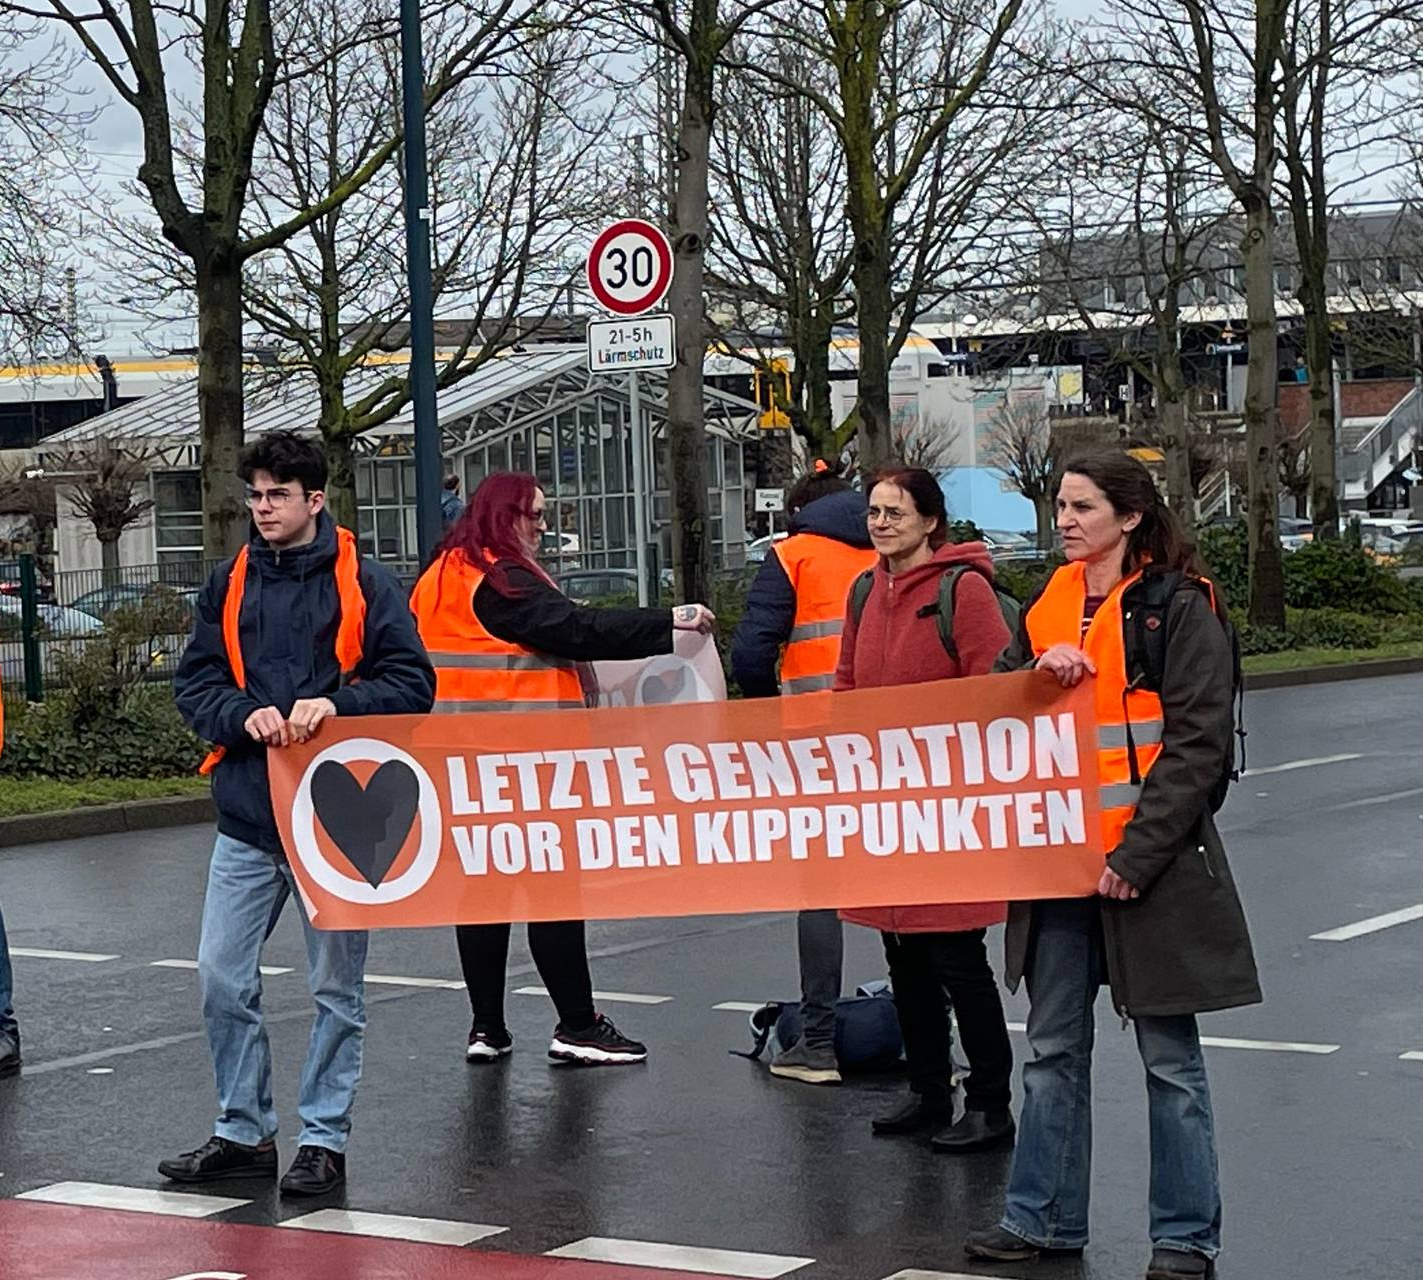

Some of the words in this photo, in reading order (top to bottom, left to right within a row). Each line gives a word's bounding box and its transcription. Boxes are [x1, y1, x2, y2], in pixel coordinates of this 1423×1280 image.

[606, 246, 653, 289] 30
[598, 345, 664, 364] Lärmschutz
[446, 745, 656, 815] LETZTE
[663, 712, 1080, 803] GENERATION
[450, 822, 565, 876] VOR
[575, 813, 682, 871] DEN
[693, 788, 1086, 865] KIPPPUNKTEN
